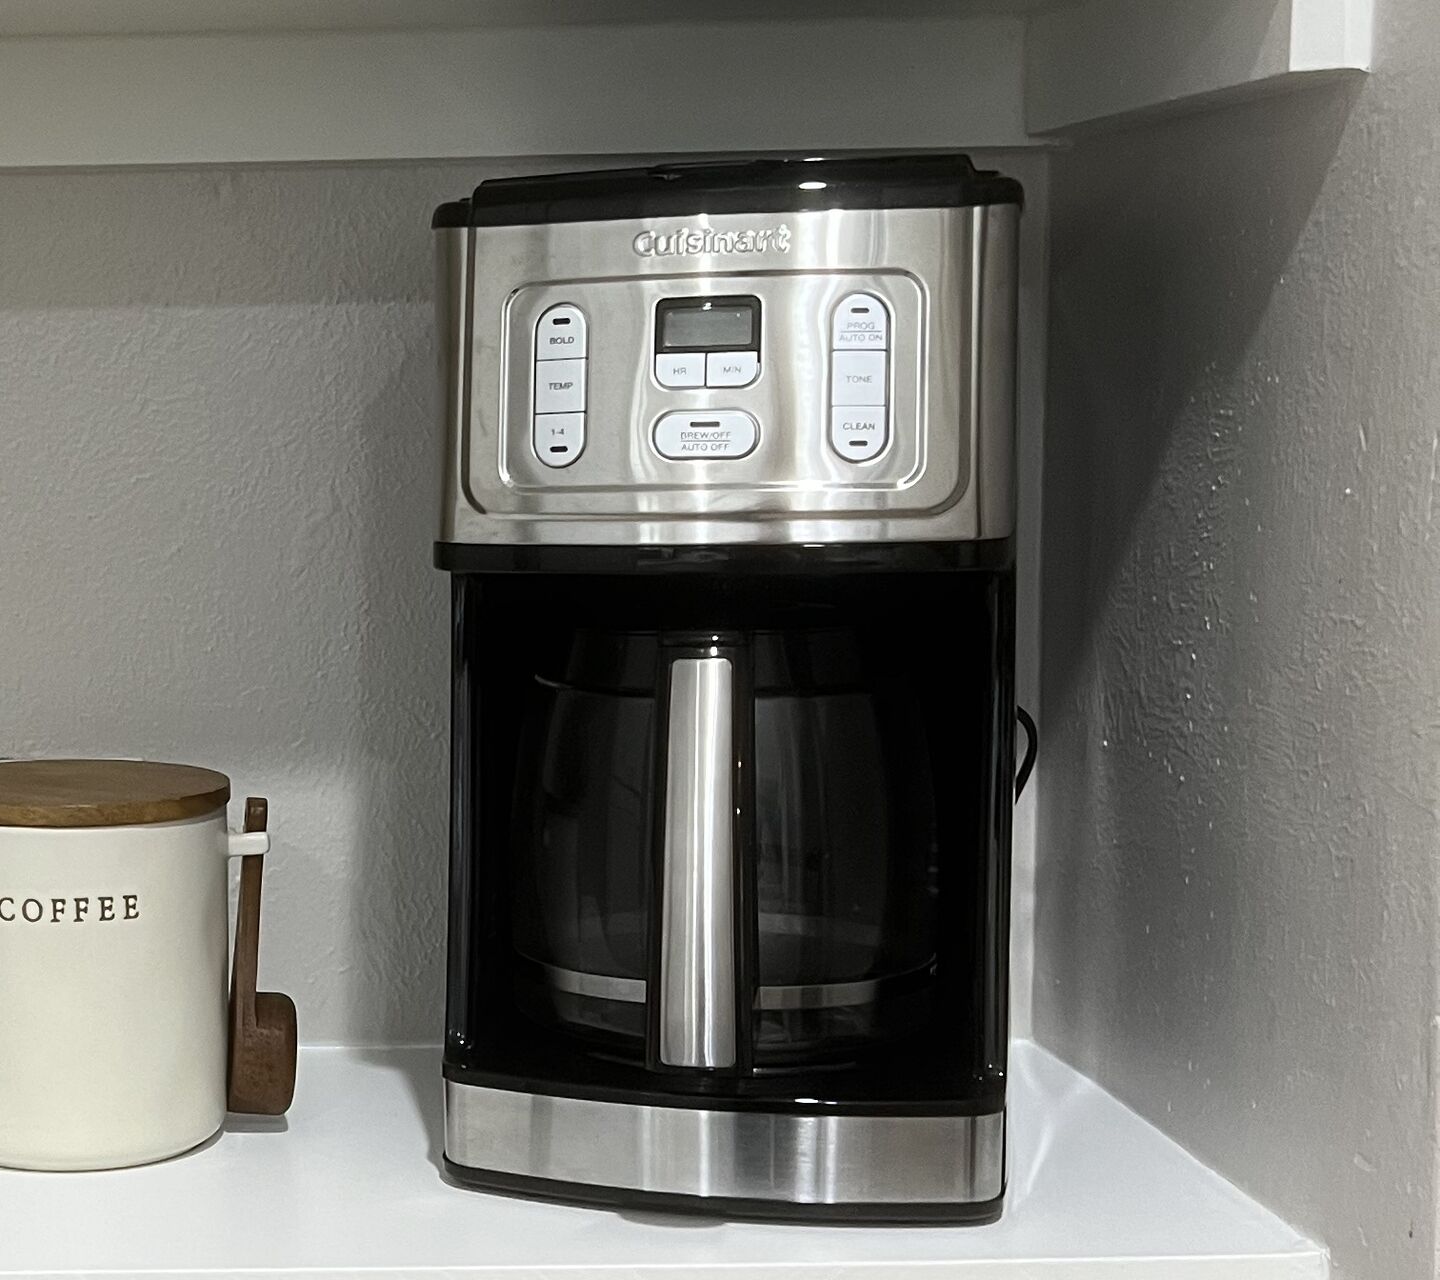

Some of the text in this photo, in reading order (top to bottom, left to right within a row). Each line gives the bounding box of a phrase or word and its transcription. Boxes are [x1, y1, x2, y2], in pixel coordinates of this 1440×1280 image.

[633, 224, 792, 257] Cuisinart
[846, 322, 876, 331] PROG
[549, 336, 575, 345] BOLD
[839, 333, 866, 343] AUTO
[673, 367, 687, 375] HR
[723, 366, 742, 374] MIN
[846, 375, 872, 384] TONE
[548, 382, 573, 391] TEMP
[842, 422, 876, 431] CLEAN
[551, 428, 565, 436] 1-4
[680, 431, 731, 440] BREW/OFF
[681, 443, 729, 451] AUTO OFF
